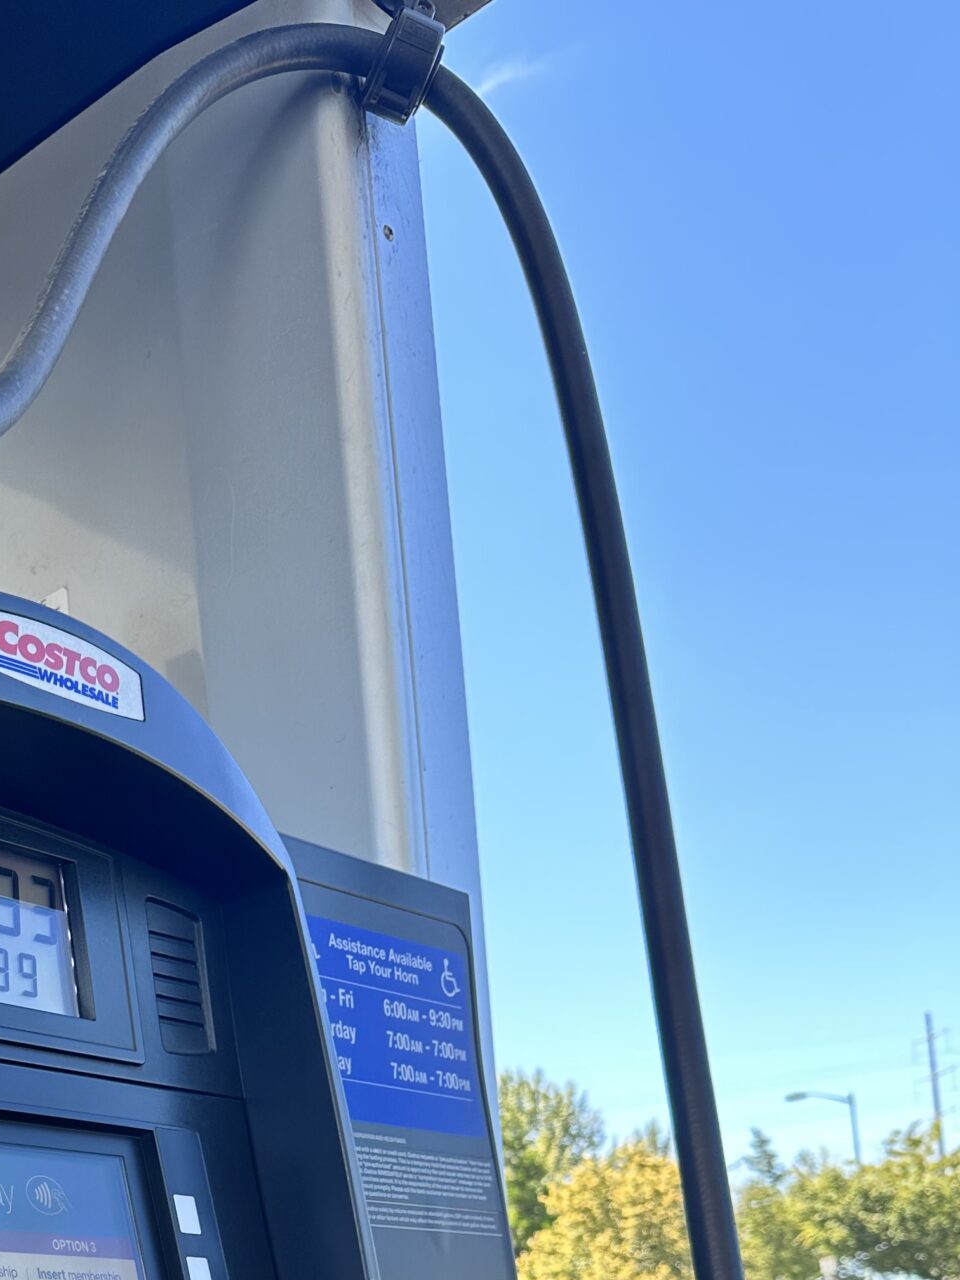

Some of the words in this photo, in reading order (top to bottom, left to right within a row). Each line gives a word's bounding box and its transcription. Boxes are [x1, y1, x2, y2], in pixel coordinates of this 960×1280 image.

[38, 667, 119, 709] WHOLESALE
[328, 933, 386, 960] Assistance
[388, 948, 432, 972] Available
[346, 955, 366, 975] Tap
[368, 960, 392, 978] Your
[394, 966, 419, 985] Horn
[338, 988, 354, 1008] Fri
[383, 998, 419, 1022] 6:00AM
[428, 1009, 463, 1031] 9:30PM
[386, 1030, 423, 1053] 7:00AM
[431, 1039, 466, 1061] 7:00PM
[390, 1061, 427, 1084] 7:00AM
[436, 1070, 470, 1091] 7:00PM
[52, 1239, 89, 1252] OPTION
[90, 1241, 96, 1252] 3
